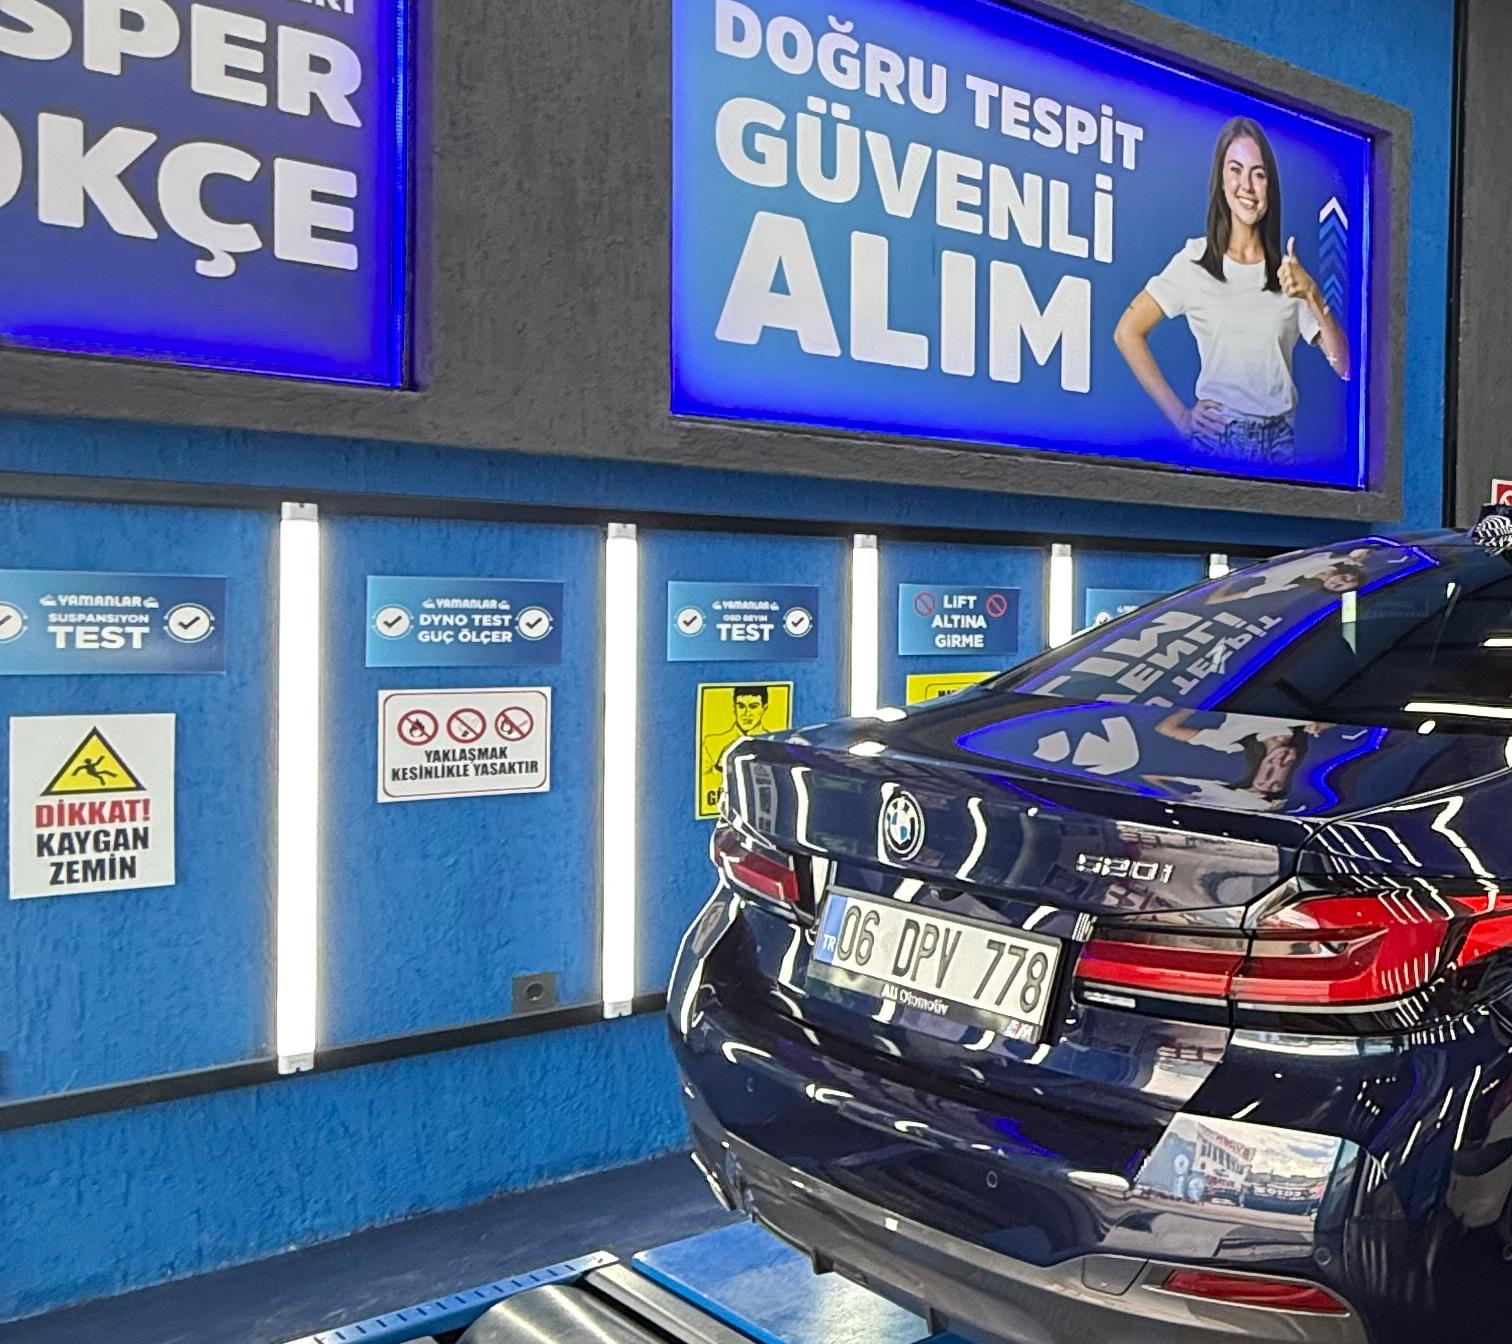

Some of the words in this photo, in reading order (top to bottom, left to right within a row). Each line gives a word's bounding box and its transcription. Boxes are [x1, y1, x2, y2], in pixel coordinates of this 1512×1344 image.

[965, 74, 1144, 170] TESPİT
[715, 97, 1113, 264] GÜVENLİ
[0, 112, 358, 278] KÇE
[715, 211, 1092, 394] ALIM
[58, 594, 142, 607] YAMANLAR
[436, 599, 498, 609] YAMANLAR
[419, 614, 468, 626] DYNO
[471, 614, 512, 626] TEST
[931, 614, 987, 629] ALTINA
[47, 626, 150, 649] TEST
[459, 628, 512, 644] ÖLÇER
[716, 623, 774, 641] TEST
[424, 746, 508, 764] YAKLAŞMAK
[391, 762, 470, 781] KESİNLİKLE
[473, 760, 538, 776] YASAKTIR
[35, 799, 151, 828] DİKKAT!
[36, 827, 149, 857] KAYGAN
[50, 853, 136, 885] ZEMİN
[822, 932, 836, 950] TR
[837, 905, 880, 966] 06
[892, 918, 962, 989] DPV
[973, 939, 1048, 1013] 778
